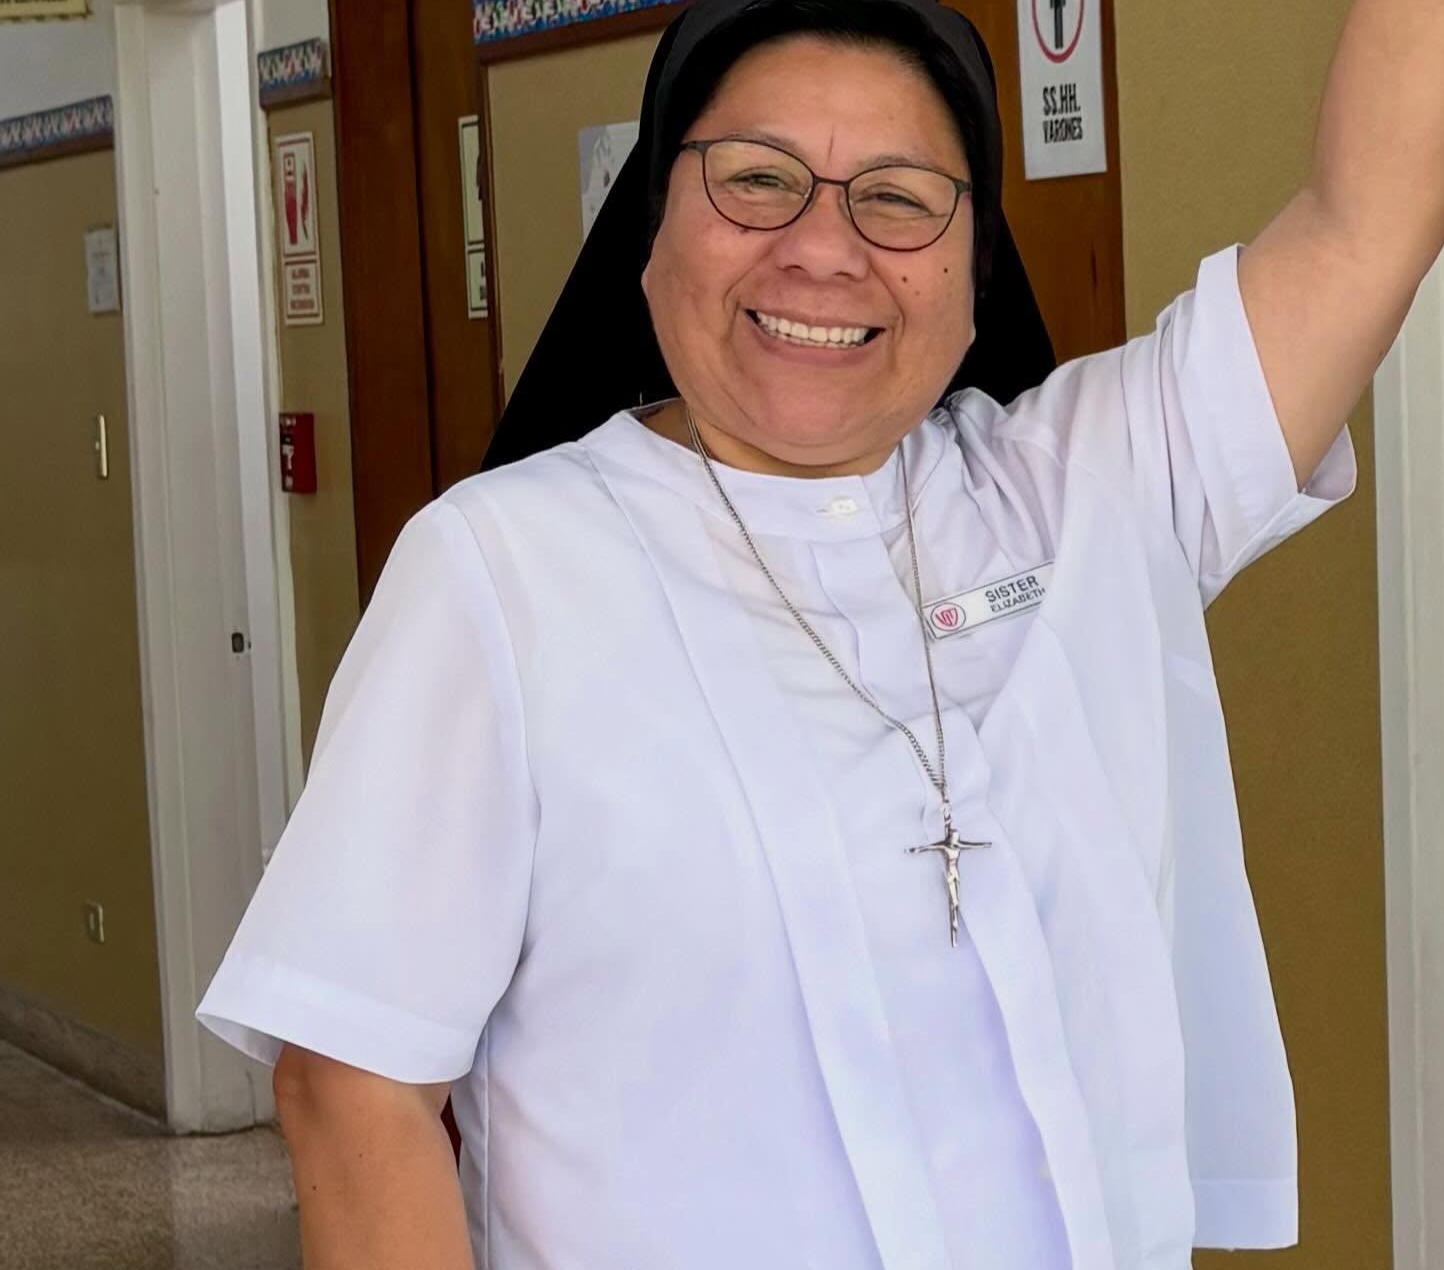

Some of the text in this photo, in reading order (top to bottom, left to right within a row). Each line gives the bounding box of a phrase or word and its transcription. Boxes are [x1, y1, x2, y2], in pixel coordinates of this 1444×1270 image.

[1042, 83, 1081, 116] SS.HH.
[1042, 116, 1083, 144] VARONES
[985, 575, 1040, 603] SISTER
